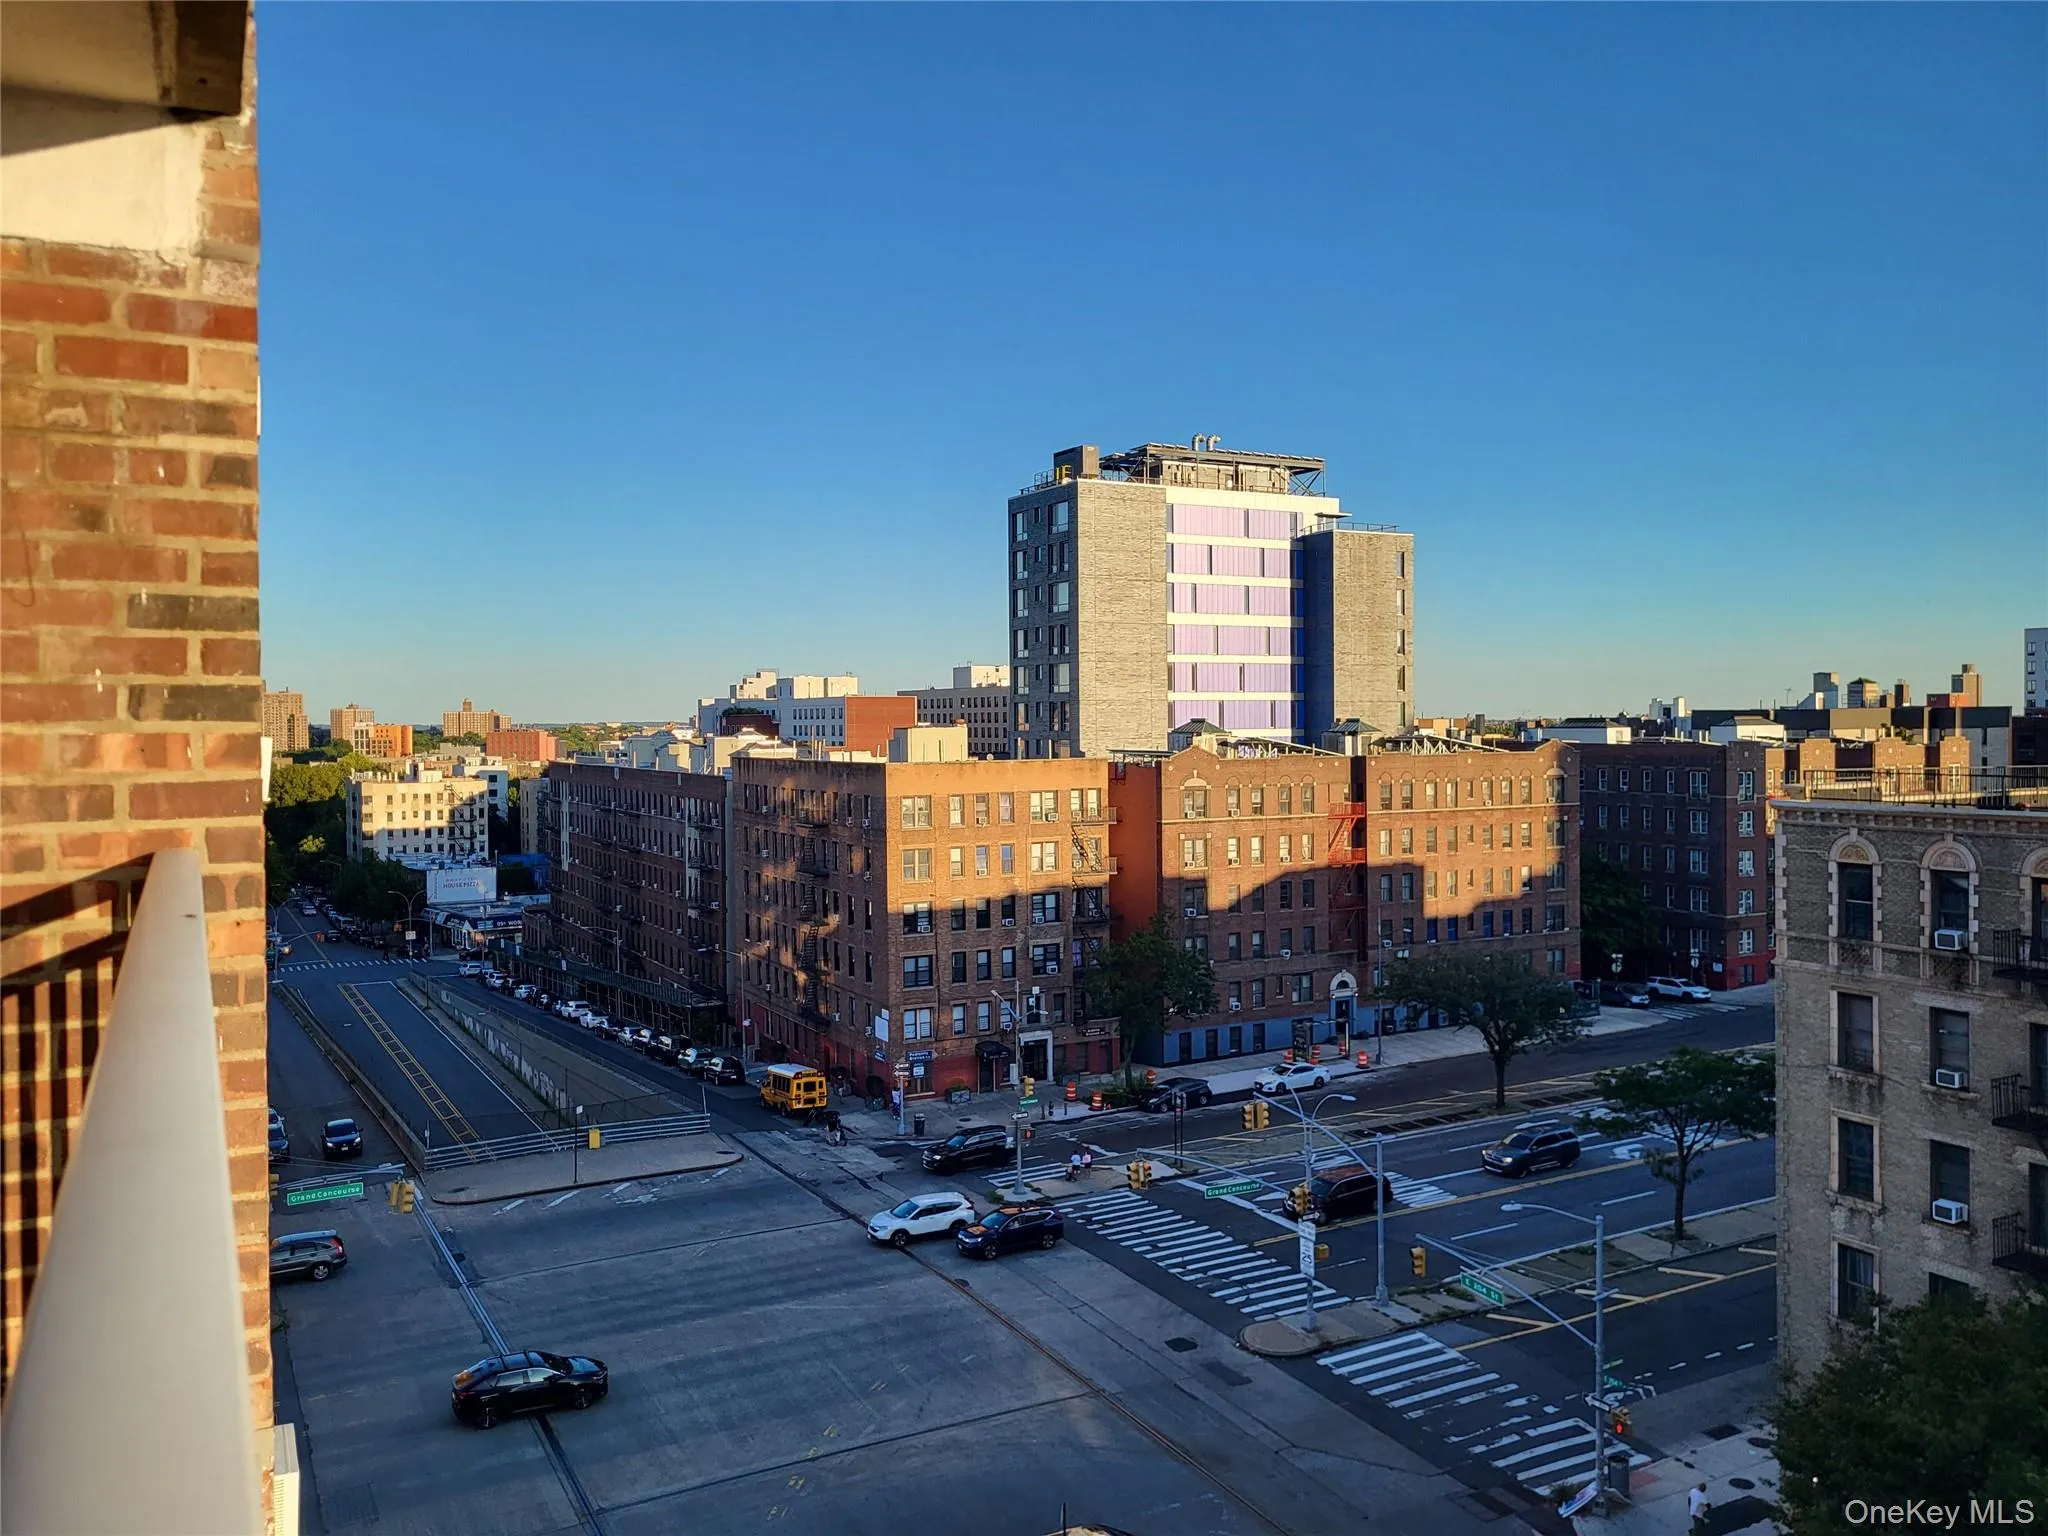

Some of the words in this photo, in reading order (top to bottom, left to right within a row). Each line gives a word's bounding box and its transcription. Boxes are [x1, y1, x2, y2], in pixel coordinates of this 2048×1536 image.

[291, 1193, 316, 1202] Grand
[317, 1187, 360, 1198] Concourse
[1207, 1187, 1227, 1196] Grand
[1227, 1183, 1260, 1193] Concourse
[1301, 1252, 1312, 1264] 25
